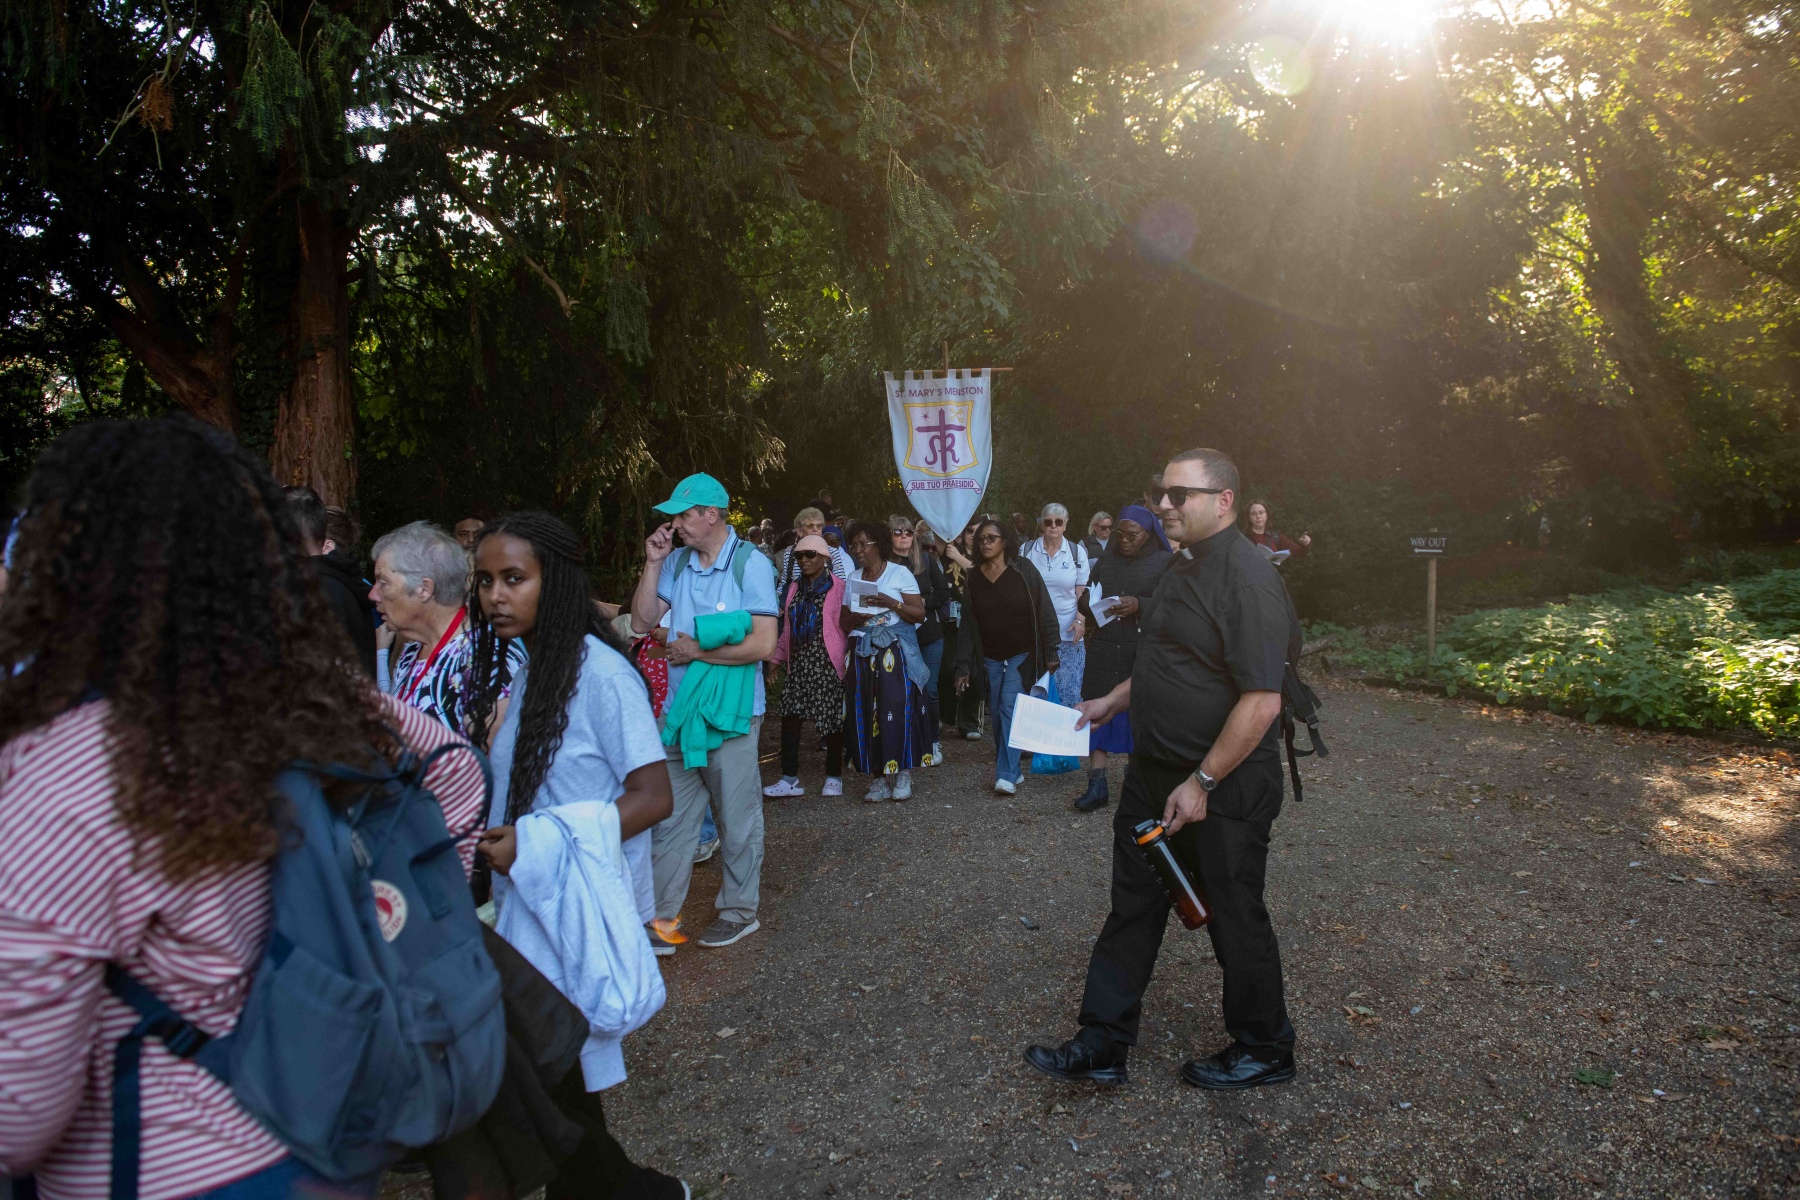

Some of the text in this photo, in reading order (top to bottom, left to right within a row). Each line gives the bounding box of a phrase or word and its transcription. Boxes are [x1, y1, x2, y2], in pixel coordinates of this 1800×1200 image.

[895, 386, 983, 398] ST. MARY'S MENSTON
[911, 480, 974, 490] SUB TUO PRAESIDIO
[1410, 537, 1446, 547] WAY OUT
